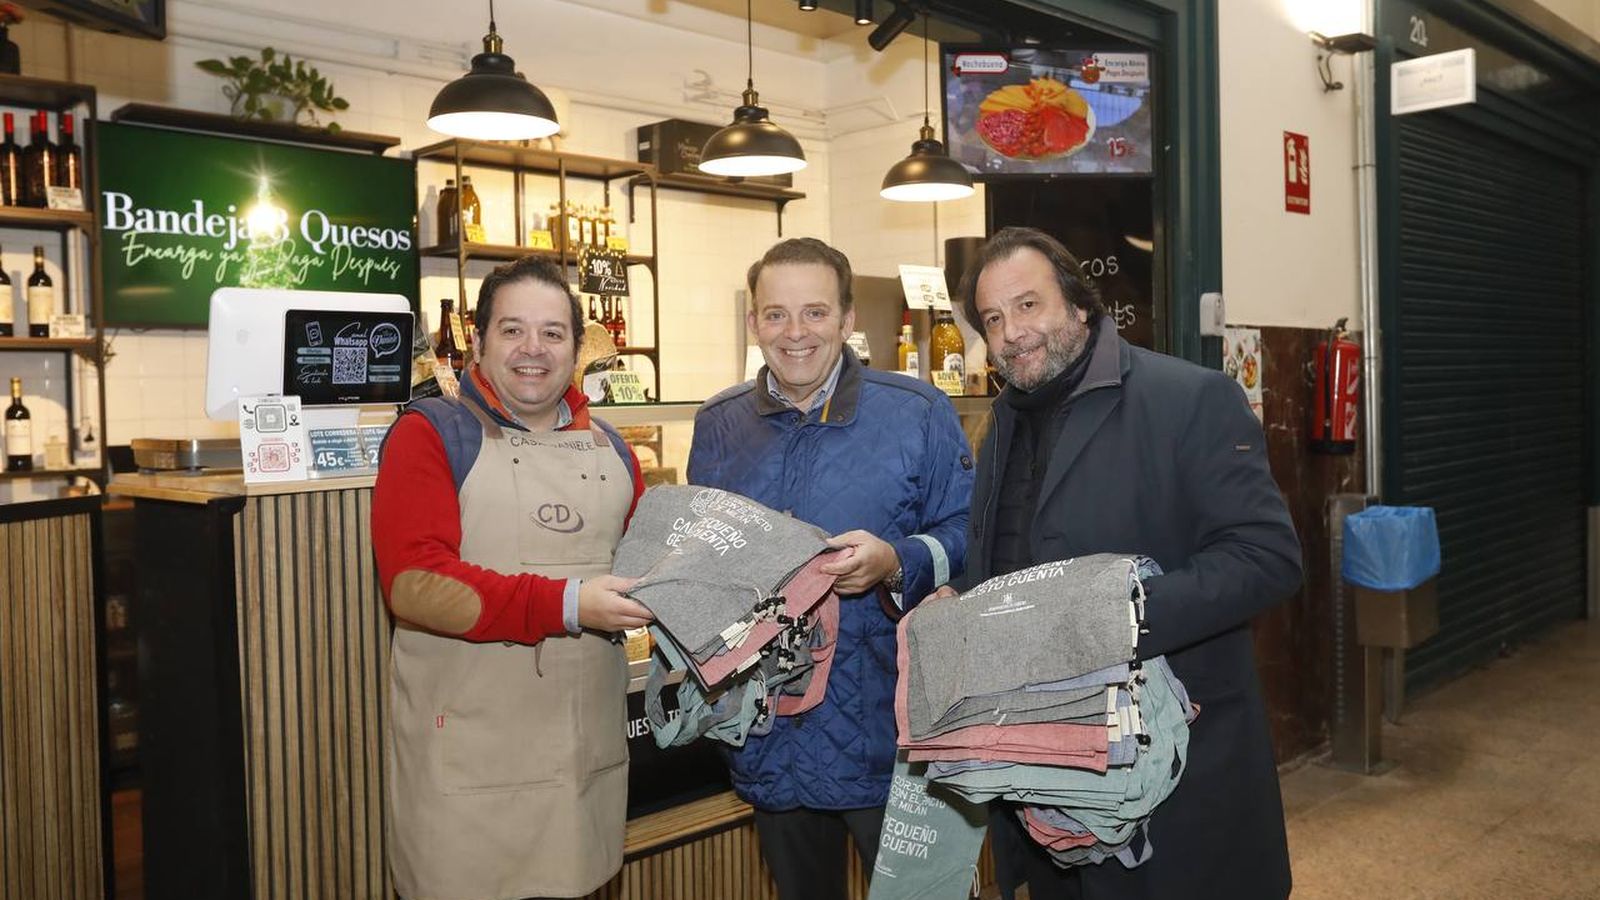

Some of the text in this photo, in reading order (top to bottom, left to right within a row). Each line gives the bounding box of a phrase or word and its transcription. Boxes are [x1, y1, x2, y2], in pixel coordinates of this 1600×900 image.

[102, 191, 252, 251] Bandeja
[300, 209, 412, 254] Quesos
[121, 231, 213, 280] Encarga
[214, 251, 245, 284] ya
[331, 242, 401, 286] Después
[588, 258, 612, 276] -10%
[609, 373, 641, 384] OFERTA
[615, 385, 644, 401] -10%
[553, 440, 595, 452] ANIELE
[317, 451, 346, 468] 45€
[368, 449, 379, 464] 2
[538, 503, 571, 524] CD
[1007, 566, 1064, 587] CUENTA
[627, 716, 651, 739] UES
[909, 793, 921, 806] EL
[881, 833, 929, 860] CUENTA
